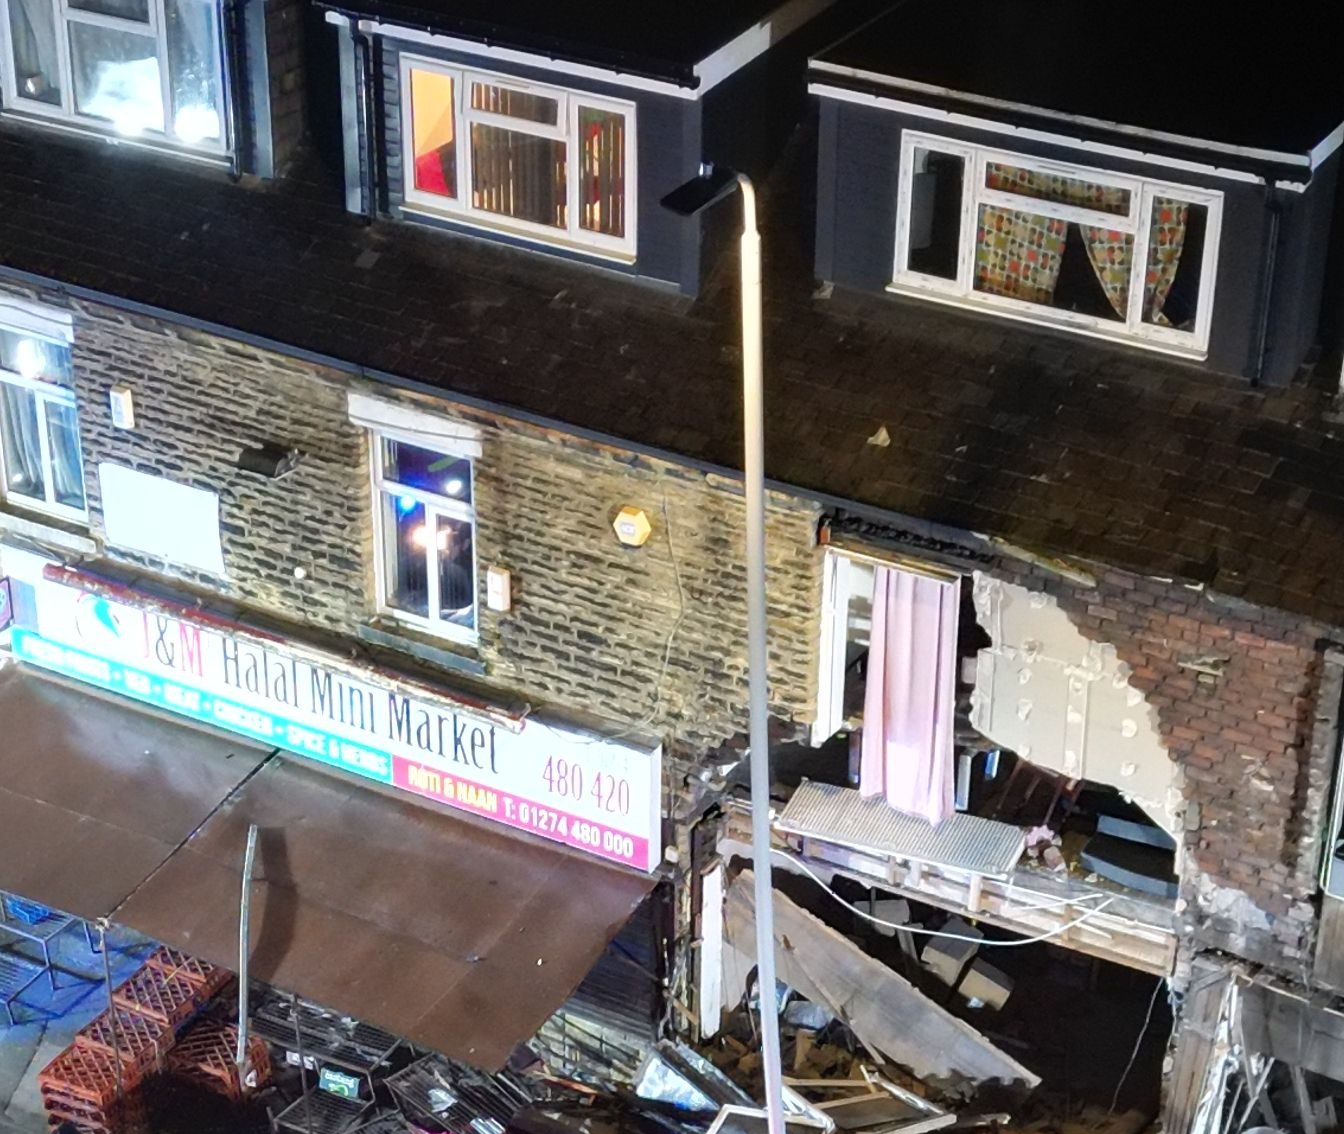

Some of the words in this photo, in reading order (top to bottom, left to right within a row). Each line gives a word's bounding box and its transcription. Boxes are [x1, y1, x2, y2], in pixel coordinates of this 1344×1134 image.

[222, 637, 299, 708] Halal
[309, 667, 376, 735] Mini
[387, 691, 500, 775] Market
[456, 778, 498, 815] NAAN
[503, 797, 517, 820] T:
[519, 805, 568, 838] 01274
[570, 821, 602, 848] 480
[603, 831, 635, 860] 000
[542, 754, 584, 802] 480
[591, 769, 631, 817] 420
